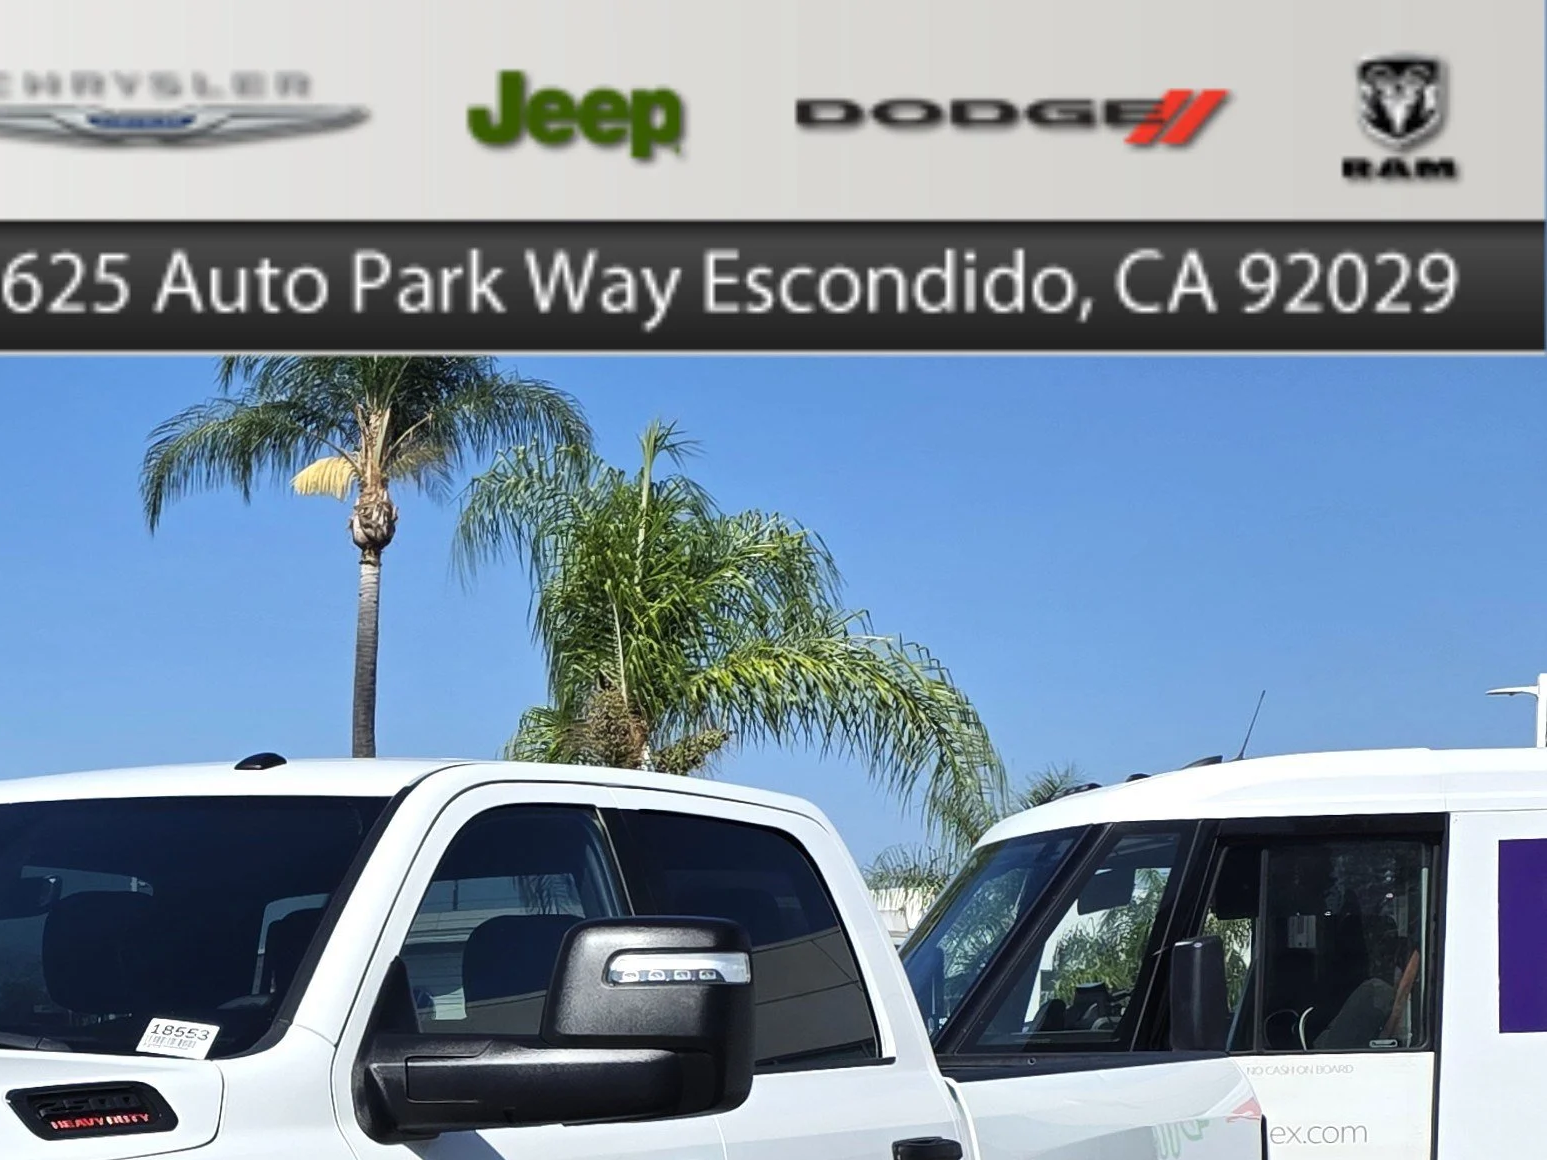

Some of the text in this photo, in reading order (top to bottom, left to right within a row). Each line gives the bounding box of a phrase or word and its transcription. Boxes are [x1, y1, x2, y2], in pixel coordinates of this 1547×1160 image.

[151, 1024, 210, 1041] 18553
[1265, 1064, 1295, 1076] CASH
[1296, 1064, 1314, 1075] ON
[1316, 1063, 1354, 1075] BOARD
[51, 1113, 150, 1130] HEAVY DUTY
[1269, 1125, 1368, 1145] ex.com
